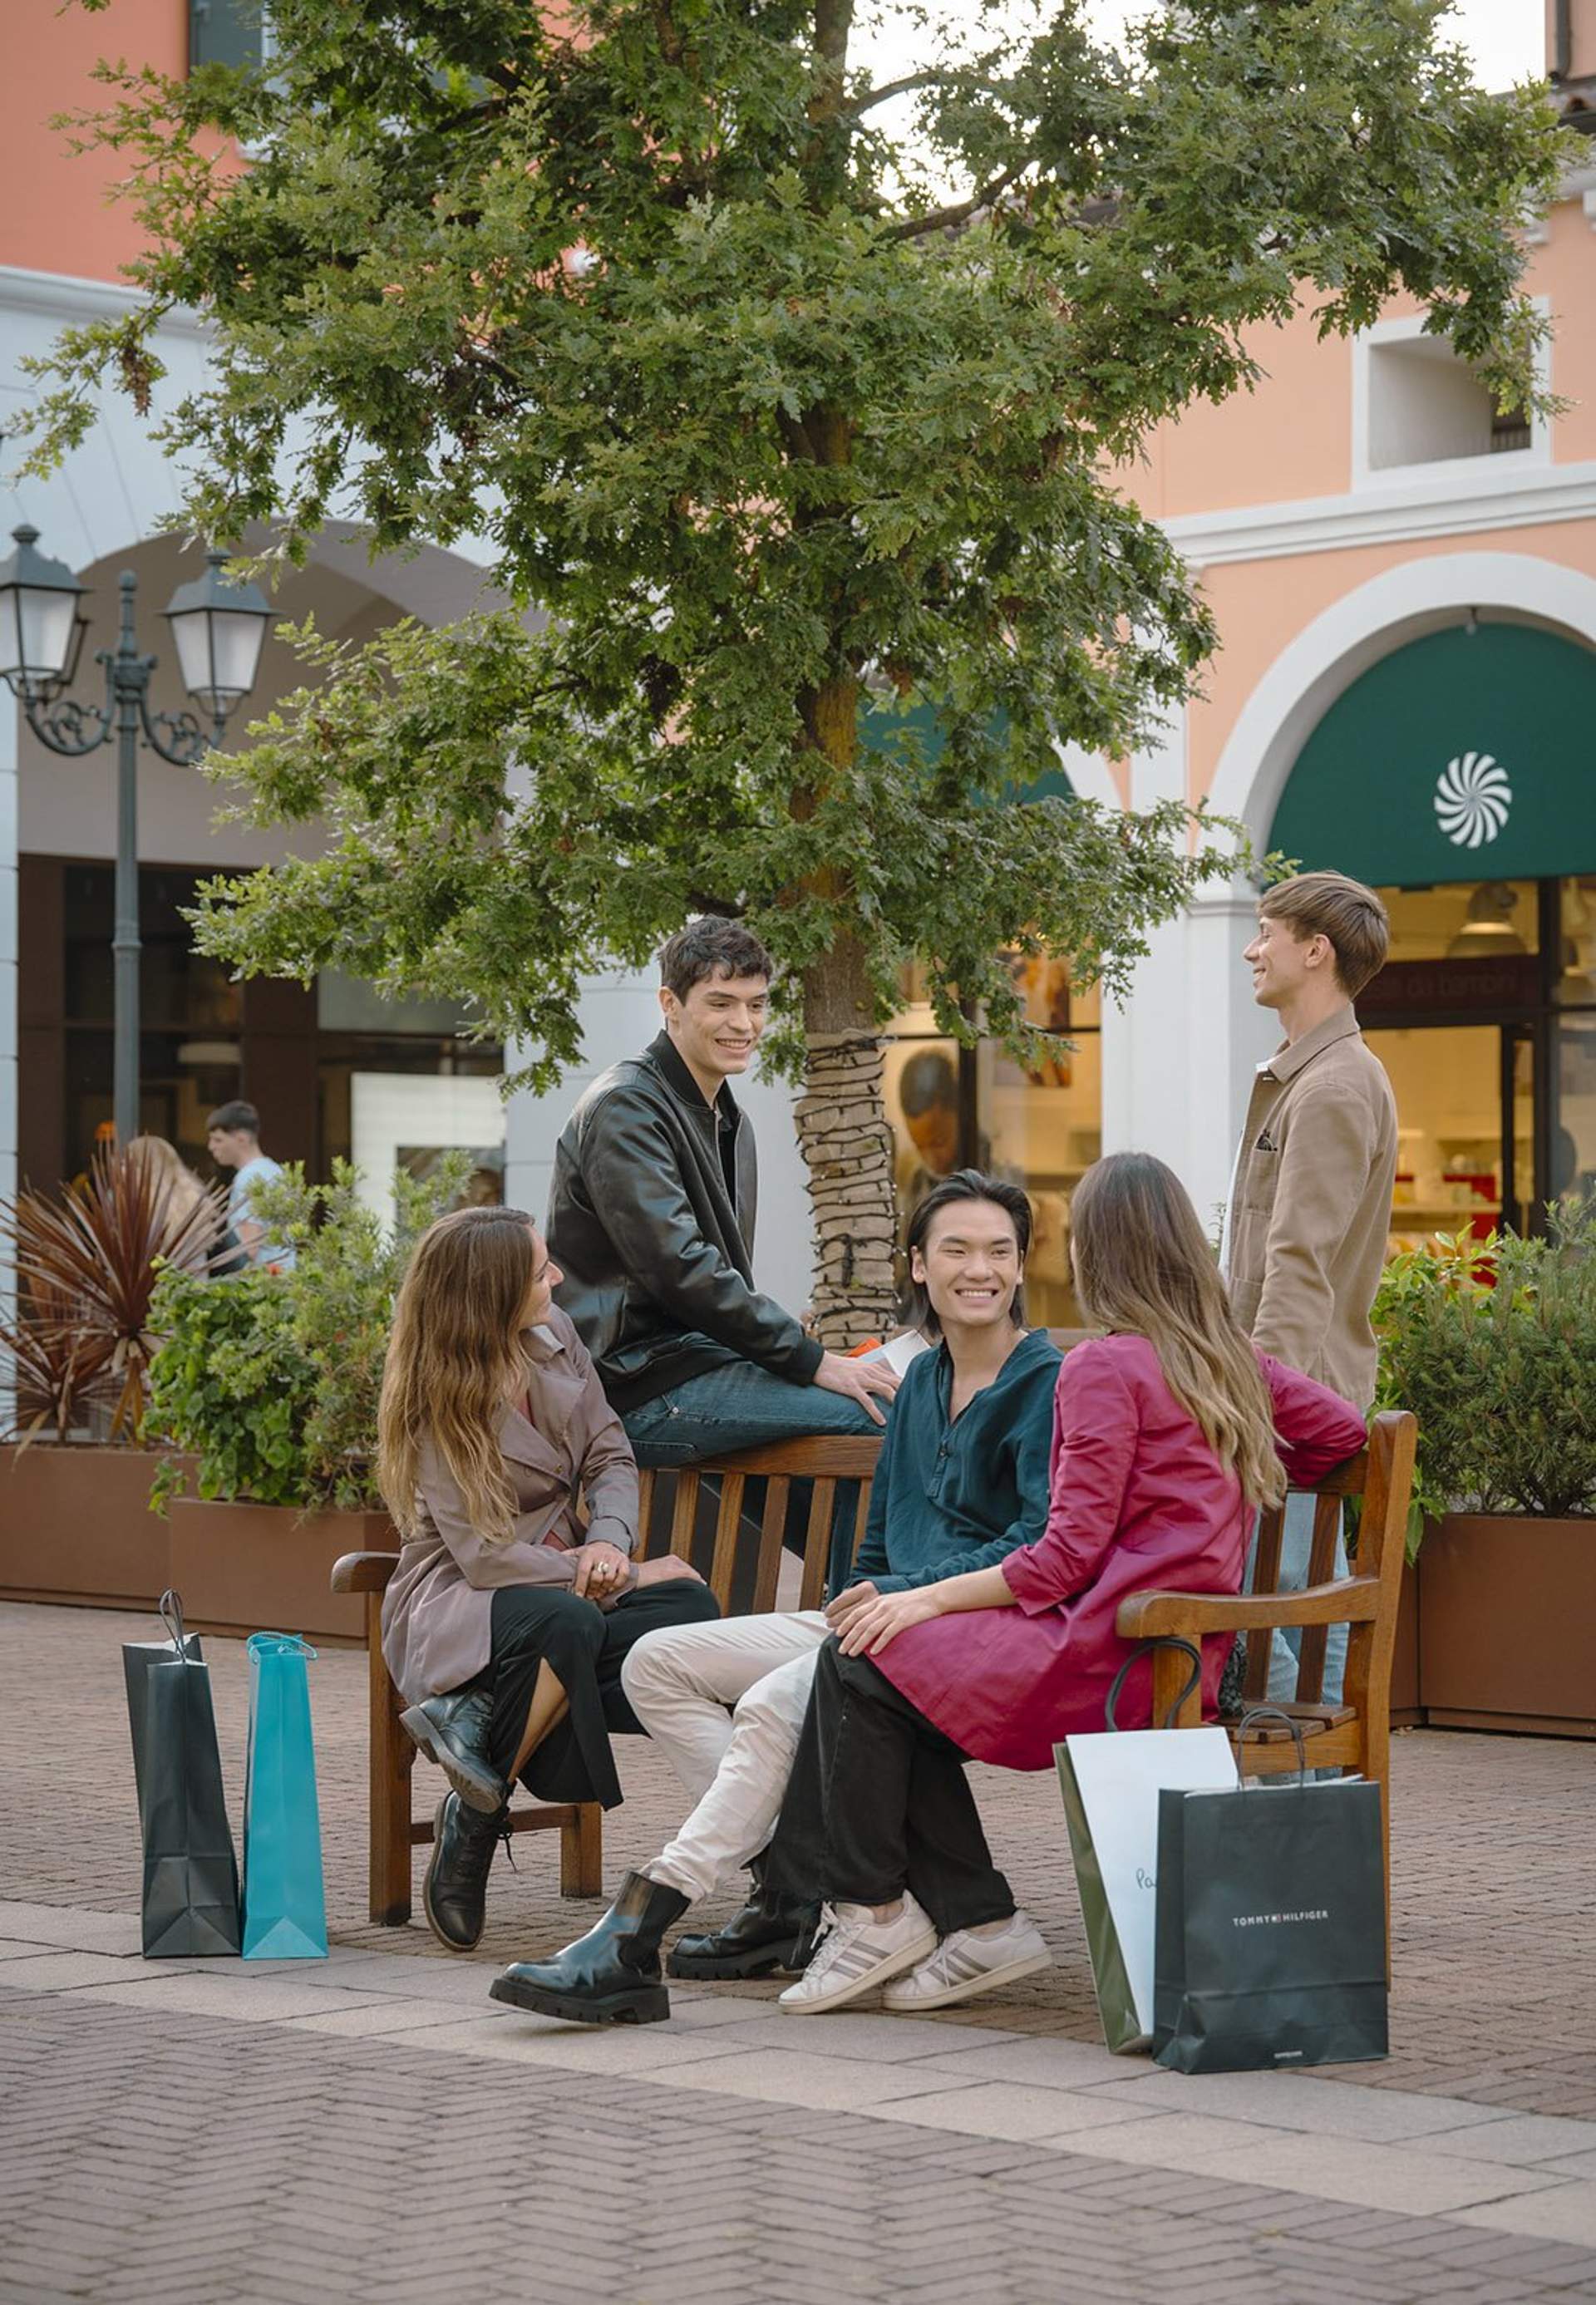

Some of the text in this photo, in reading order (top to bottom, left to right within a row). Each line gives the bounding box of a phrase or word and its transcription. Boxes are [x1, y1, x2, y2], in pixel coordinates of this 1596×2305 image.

[1135, 1868, 1155, 1889] Pa
[1233, 1910, 1328, 1927] TOMMY HILFIGER
